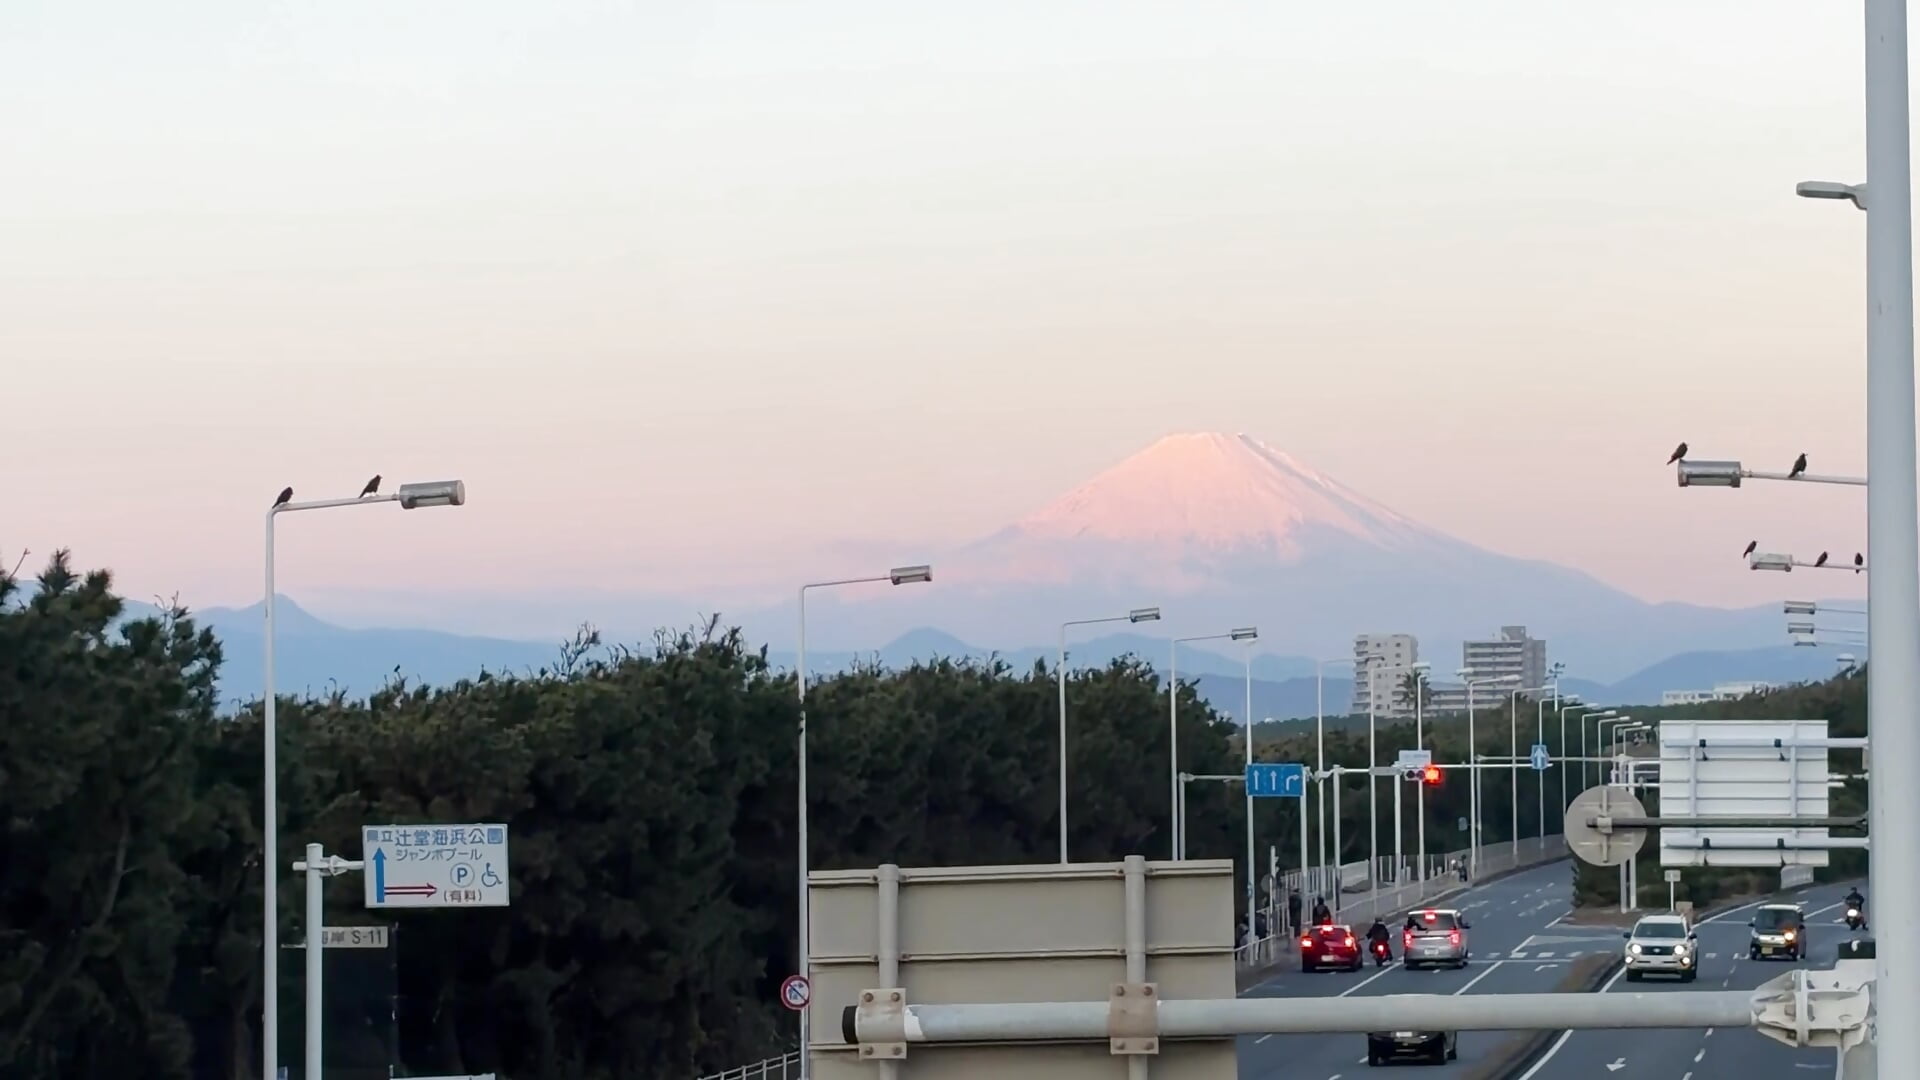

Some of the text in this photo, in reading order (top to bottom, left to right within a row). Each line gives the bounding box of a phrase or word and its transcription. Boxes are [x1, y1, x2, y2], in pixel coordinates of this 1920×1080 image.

[366, 828, 503, 846] 立辻堂海浜公
[457, 867, 468, 883] P
[352, 929, 382, 945] S-11
